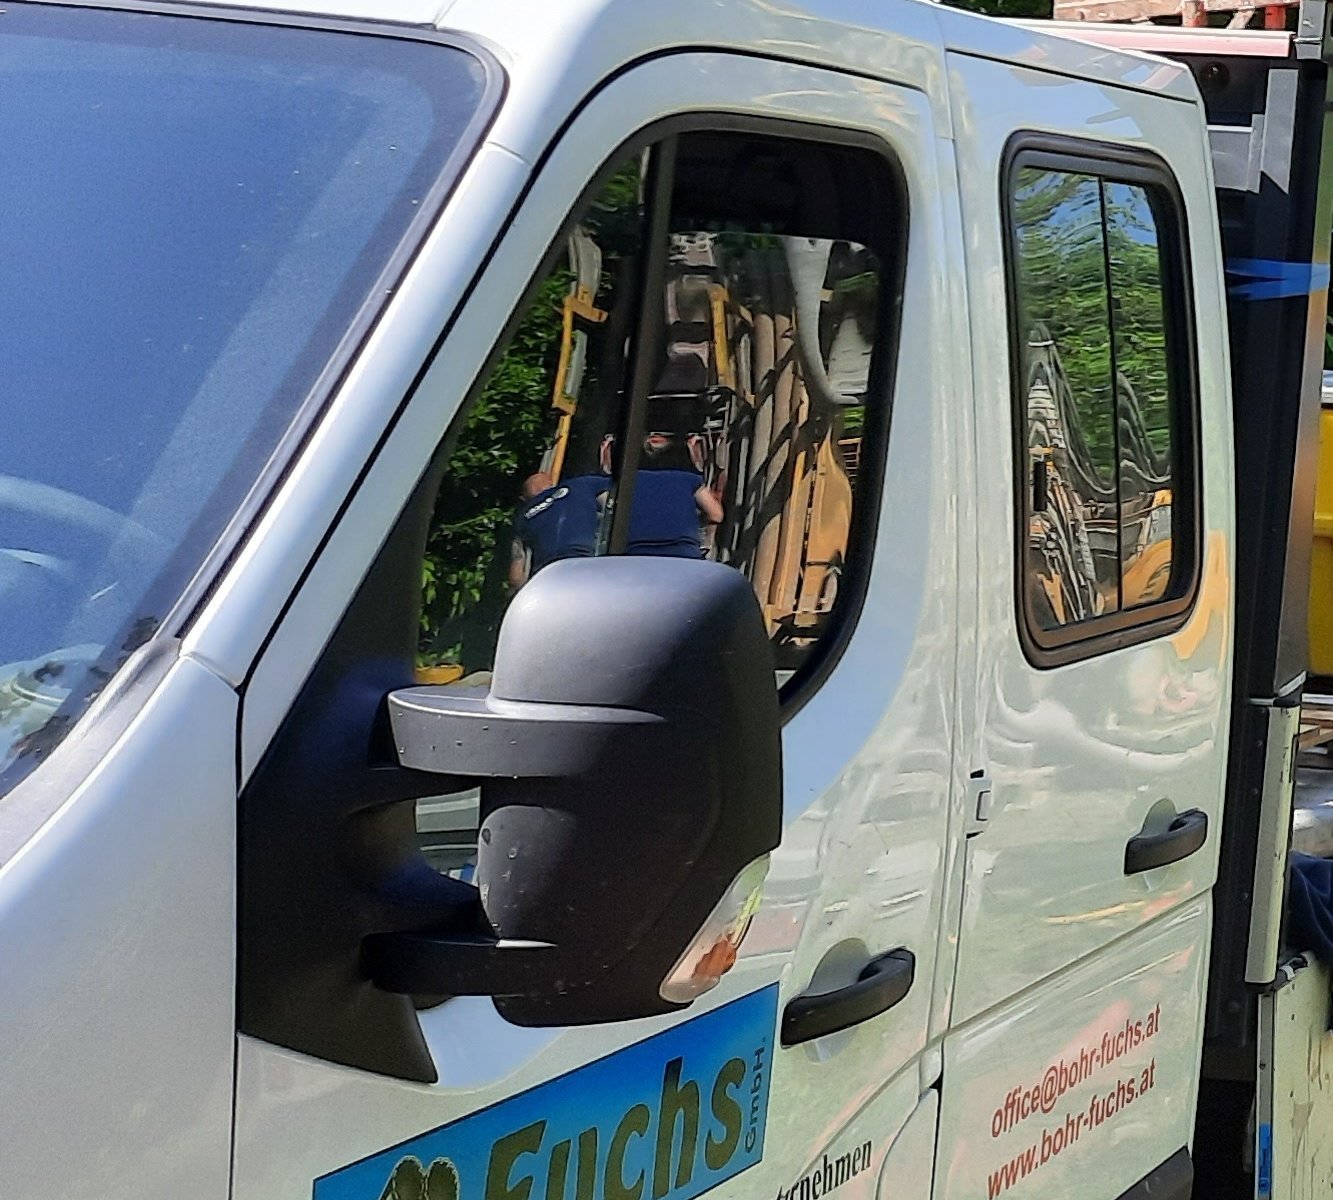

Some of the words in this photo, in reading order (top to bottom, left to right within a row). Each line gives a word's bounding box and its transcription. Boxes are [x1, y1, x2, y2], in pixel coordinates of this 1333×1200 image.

[485, 1055, 747, 1200] Fuchs
[987, 1057, 1155, 1200] www.bohr-fuchs.at
[991, 1002, 1161, 1138] office@bohr-fuchs.at
